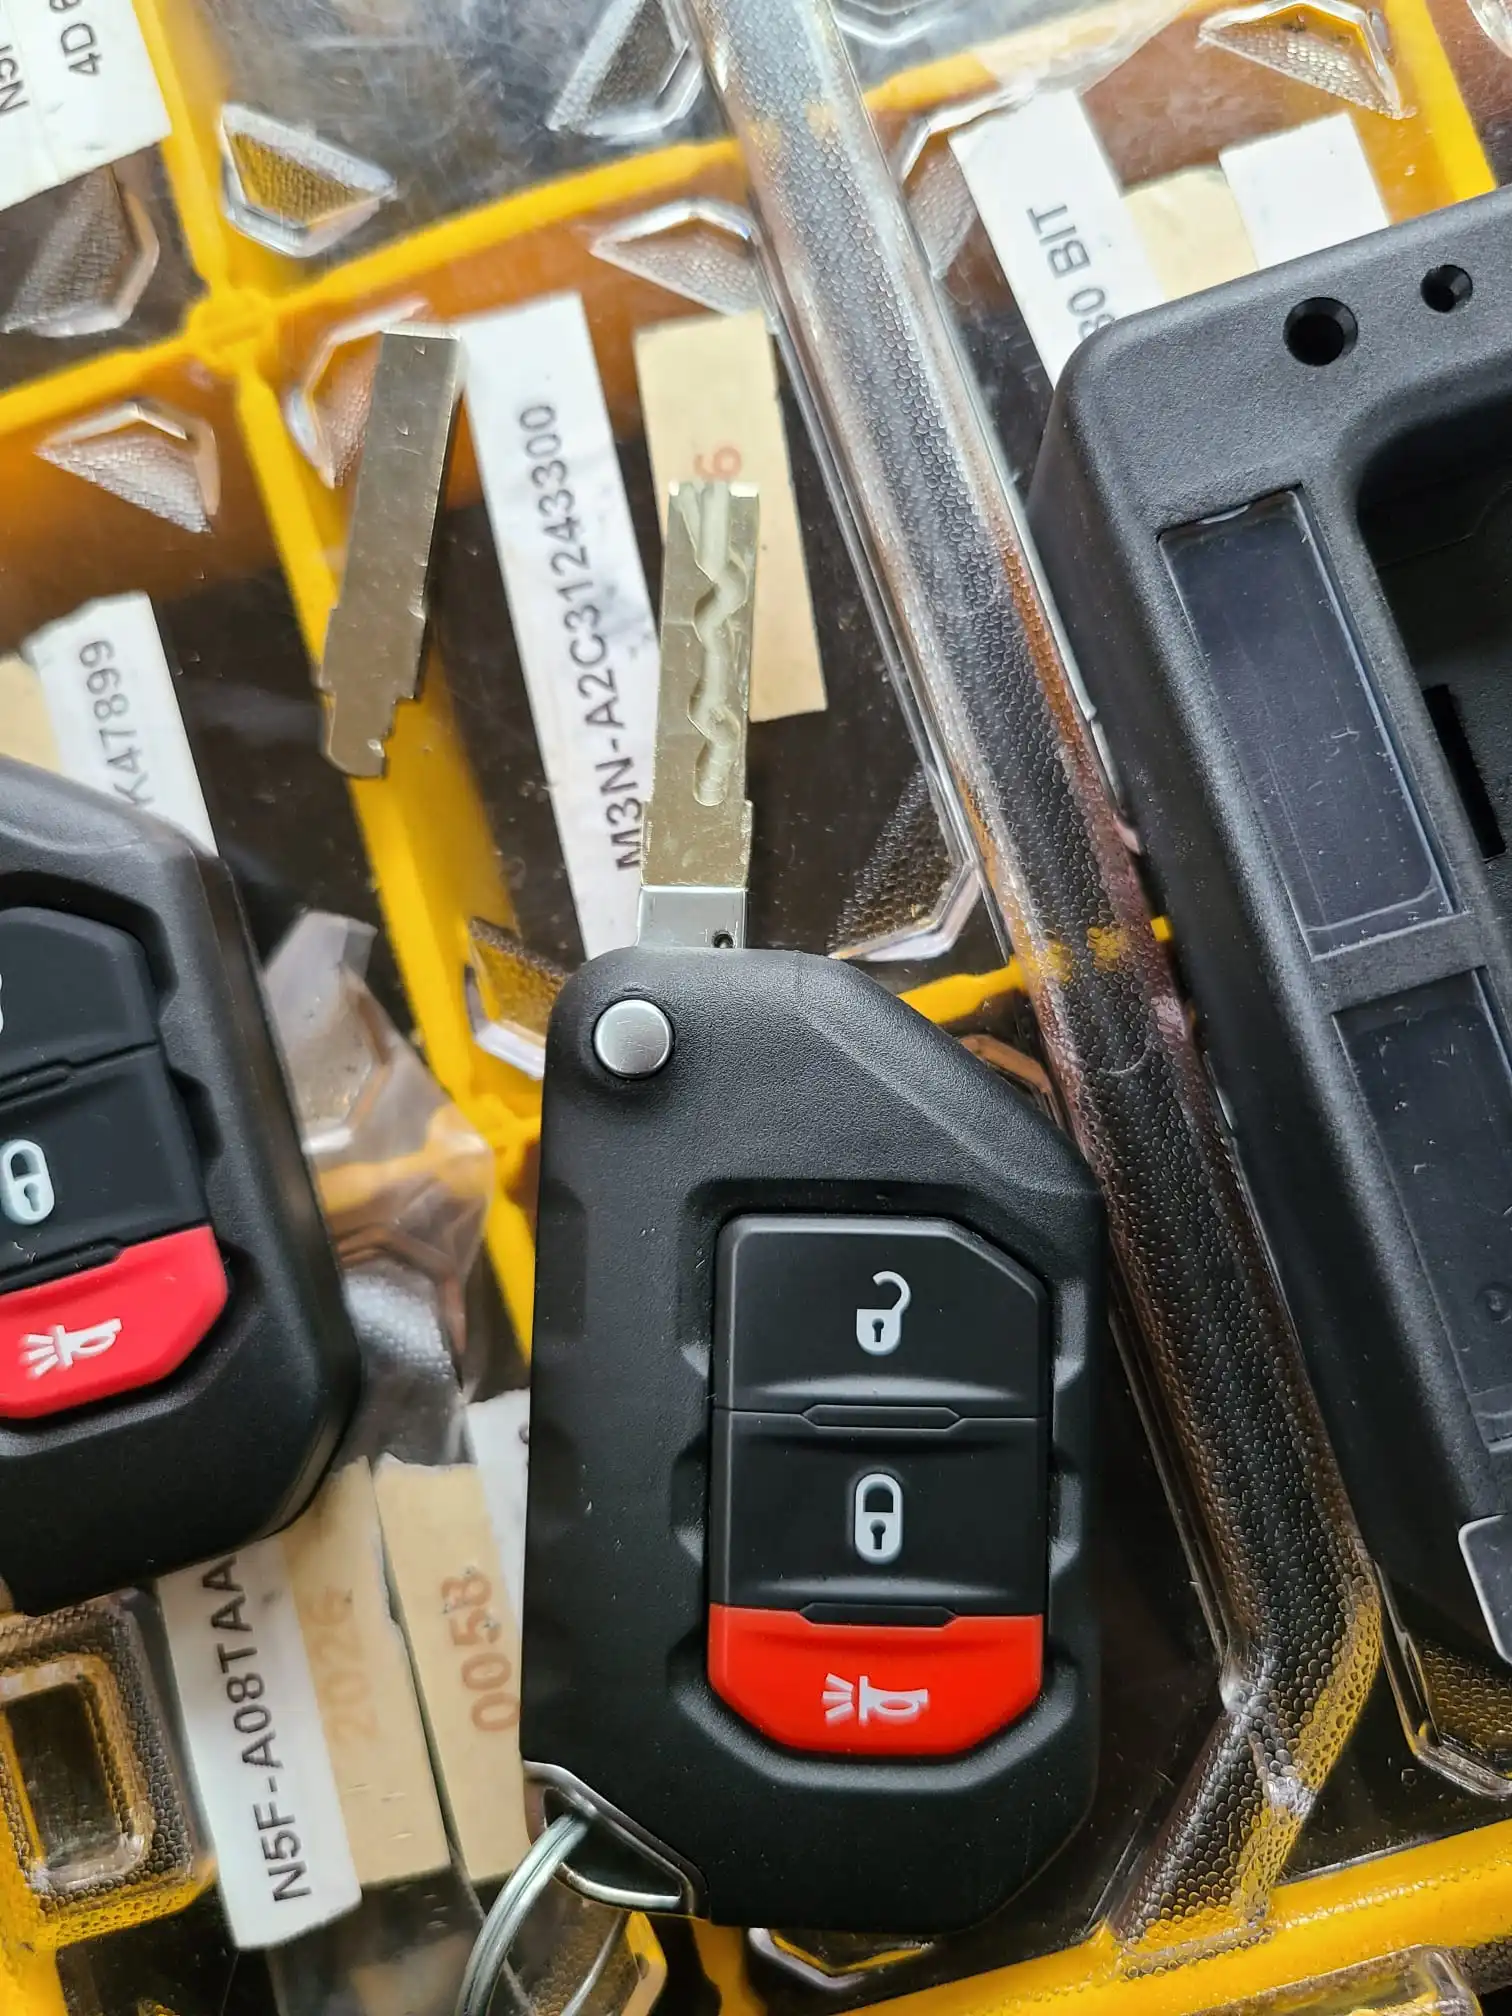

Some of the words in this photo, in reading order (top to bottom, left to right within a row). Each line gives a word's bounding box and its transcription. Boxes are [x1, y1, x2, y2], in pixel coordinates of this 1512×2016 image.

[60, 22, 101, 76] 4D
[1026, 204, 1091, 280] BIT
[518, 404, 642, 870] M3N-A2C31243300
[78, 639, 155, 805] K47899
[201, 1555, 312, 1902] N5F-A08TAA
